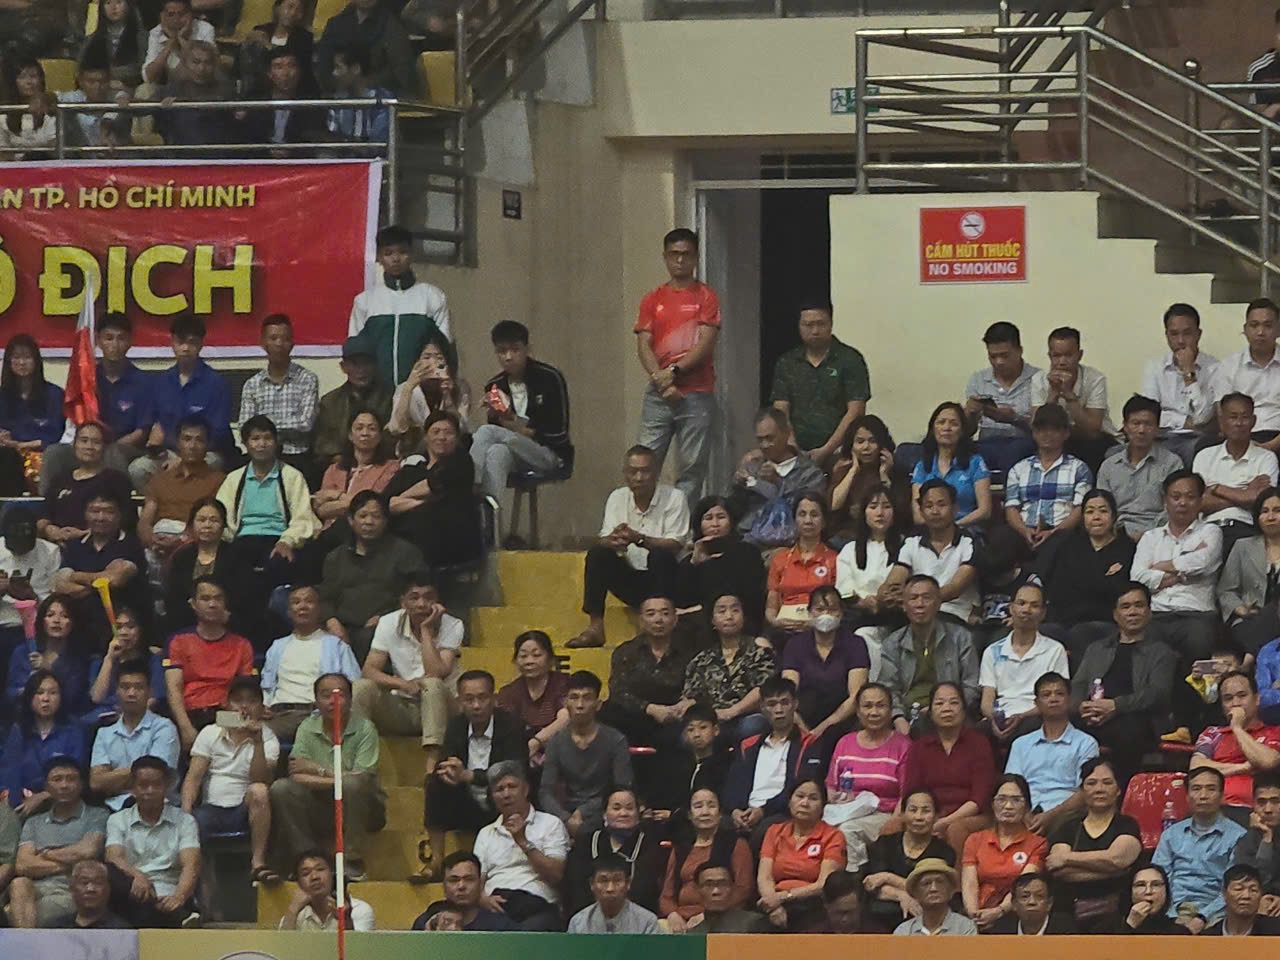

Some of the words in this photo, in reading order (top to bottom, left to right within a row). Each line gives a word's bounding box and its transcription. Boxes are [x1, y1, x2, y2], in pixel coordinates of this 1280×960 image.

[0, 187, 23, 209] N
[29, 187, 70, 208] TP.
[126, 180, 174, 208] CHÍ
[180, 185, 256, 208] MINH
[929, 263, 949, 275] NO
[953, 262, 1017, 275] SMOKING
